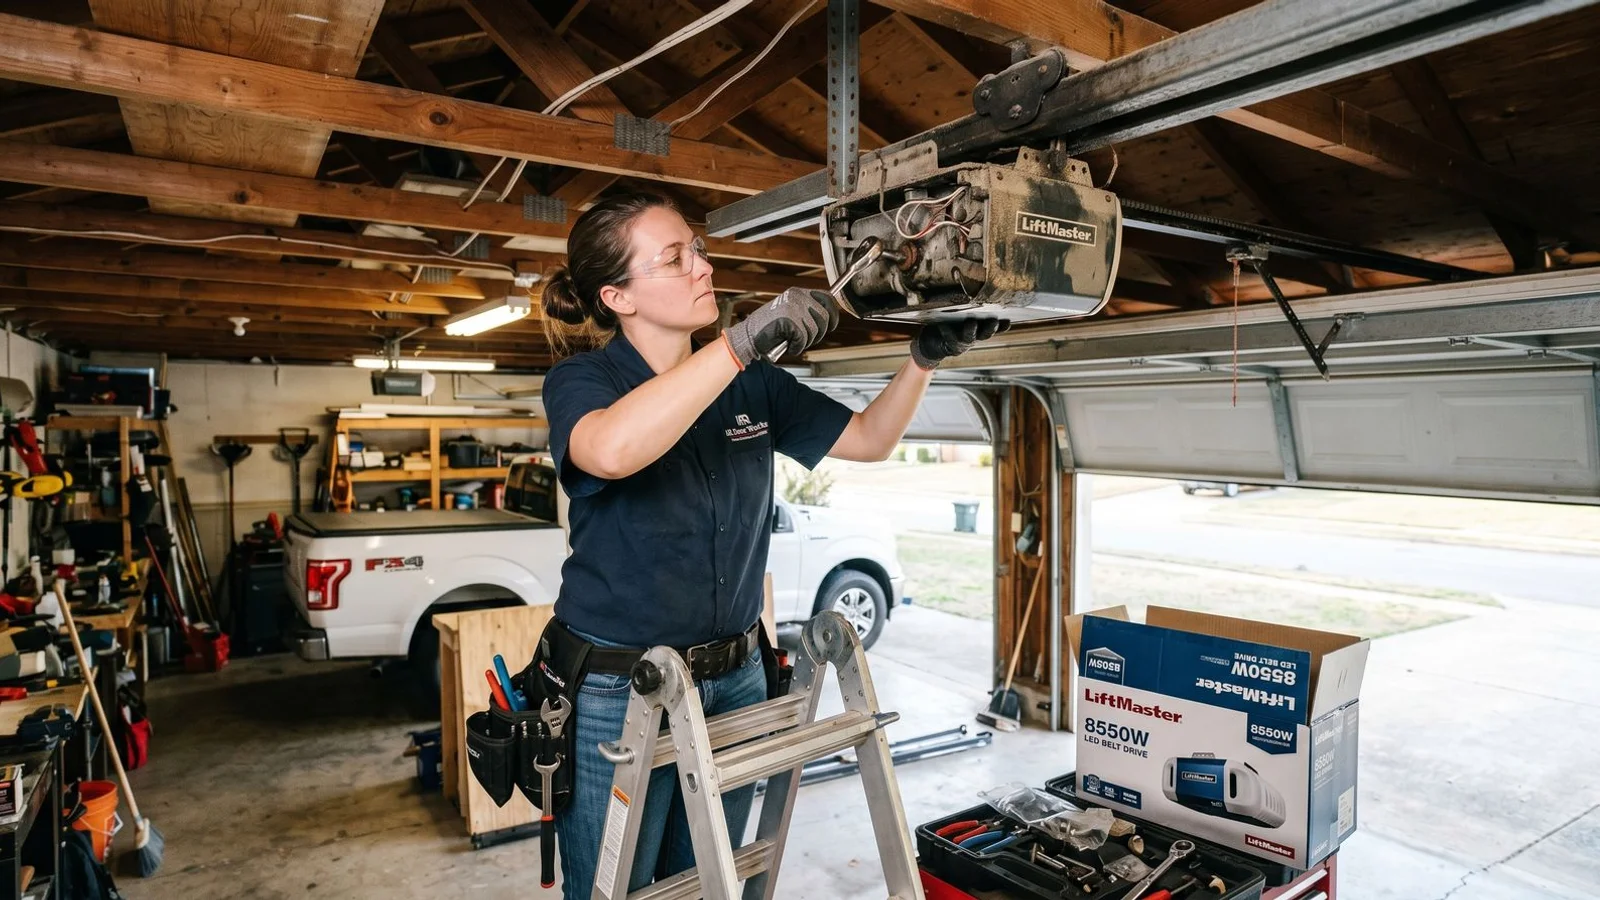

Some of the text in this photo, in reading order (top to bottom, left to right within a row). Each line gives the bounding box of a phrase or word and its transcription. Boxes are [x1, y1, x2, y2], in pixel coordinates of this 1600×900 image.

[1022, 217, 1091, 241] LiftMaster
[365, 556, 424, 571] FX4
[1234, 652, 1257, 662] DRIVE
[1259, 657, 1278, 667] BELT
[1281, 662, 1297, 670] LED
[1231, 661, 1297, 686] 8550W
[1196, 677, 1296, 711] LiftMaster
[1084, 688, 1183, 723] LiftMaster
[1084, 717, 1150, 747] 8550W
[1250, 724, 1294, 742] 8550W
[1084, 734, 1148, 759] LED BELT DRIVE
[1247, 836, 1292, 856] LiftMaster
